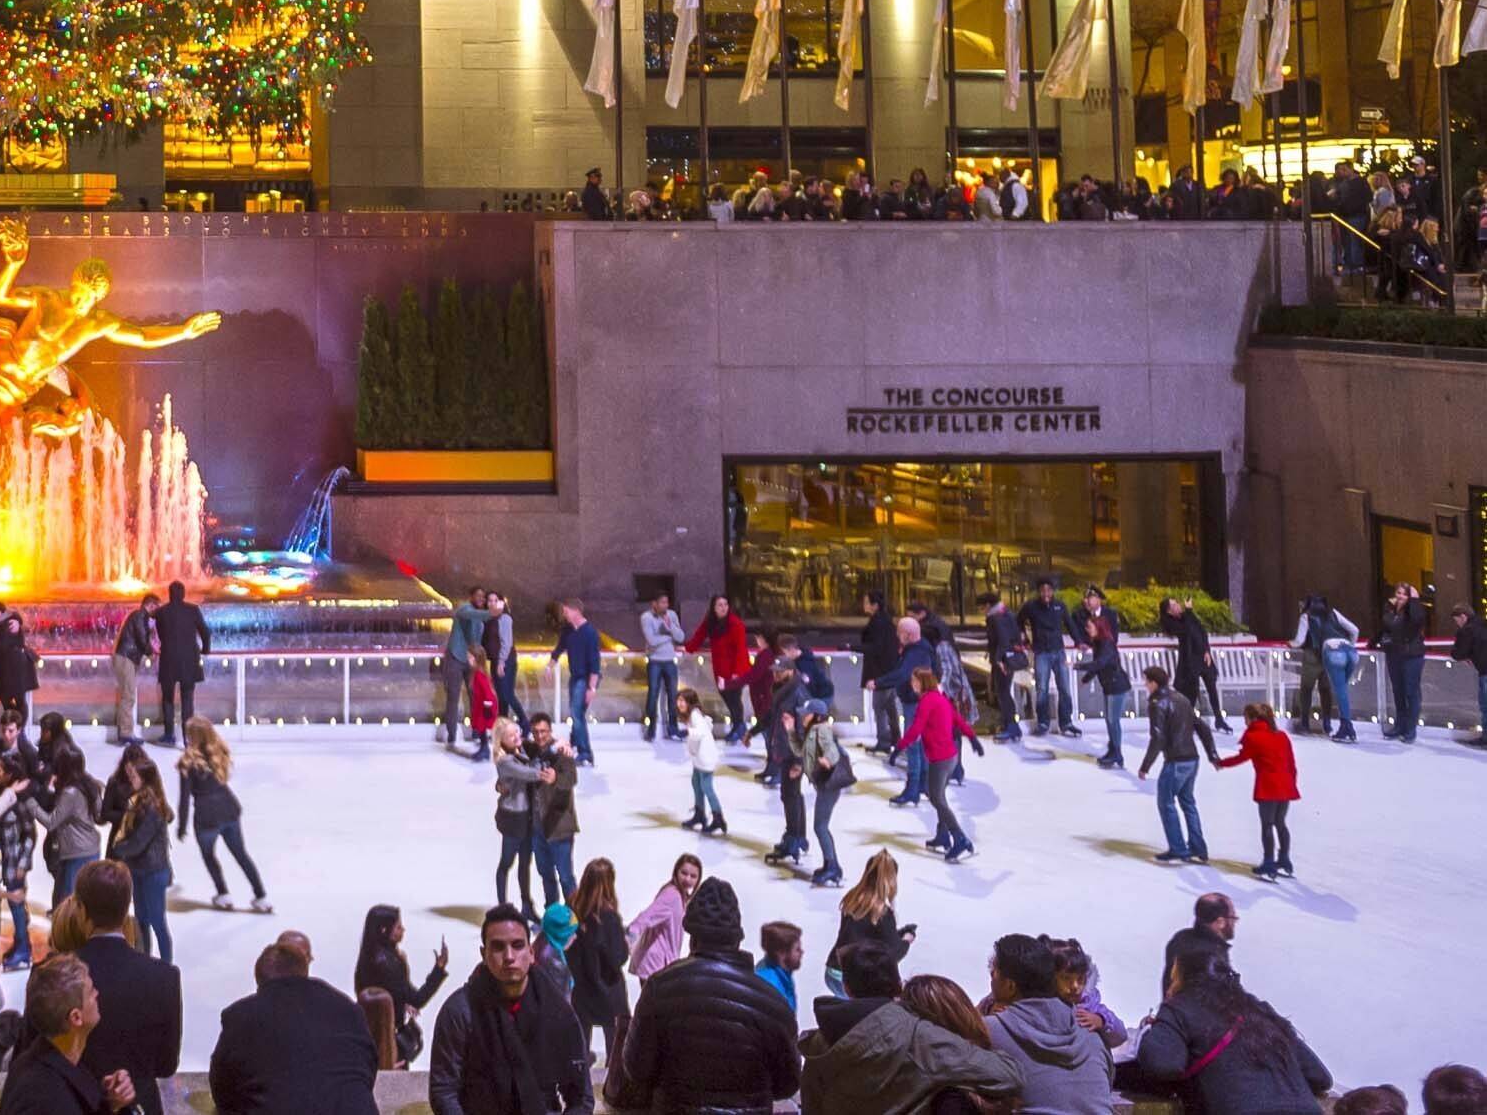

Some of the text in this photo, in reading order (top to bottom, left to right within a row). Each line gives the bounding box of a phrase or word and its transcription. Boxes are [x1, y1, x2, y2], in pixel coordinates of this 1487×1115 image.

[883, 386, 1066, 406] THE CONCOURSE
[846, 413, 1102, 434] ROCKEFELLER CENTER
